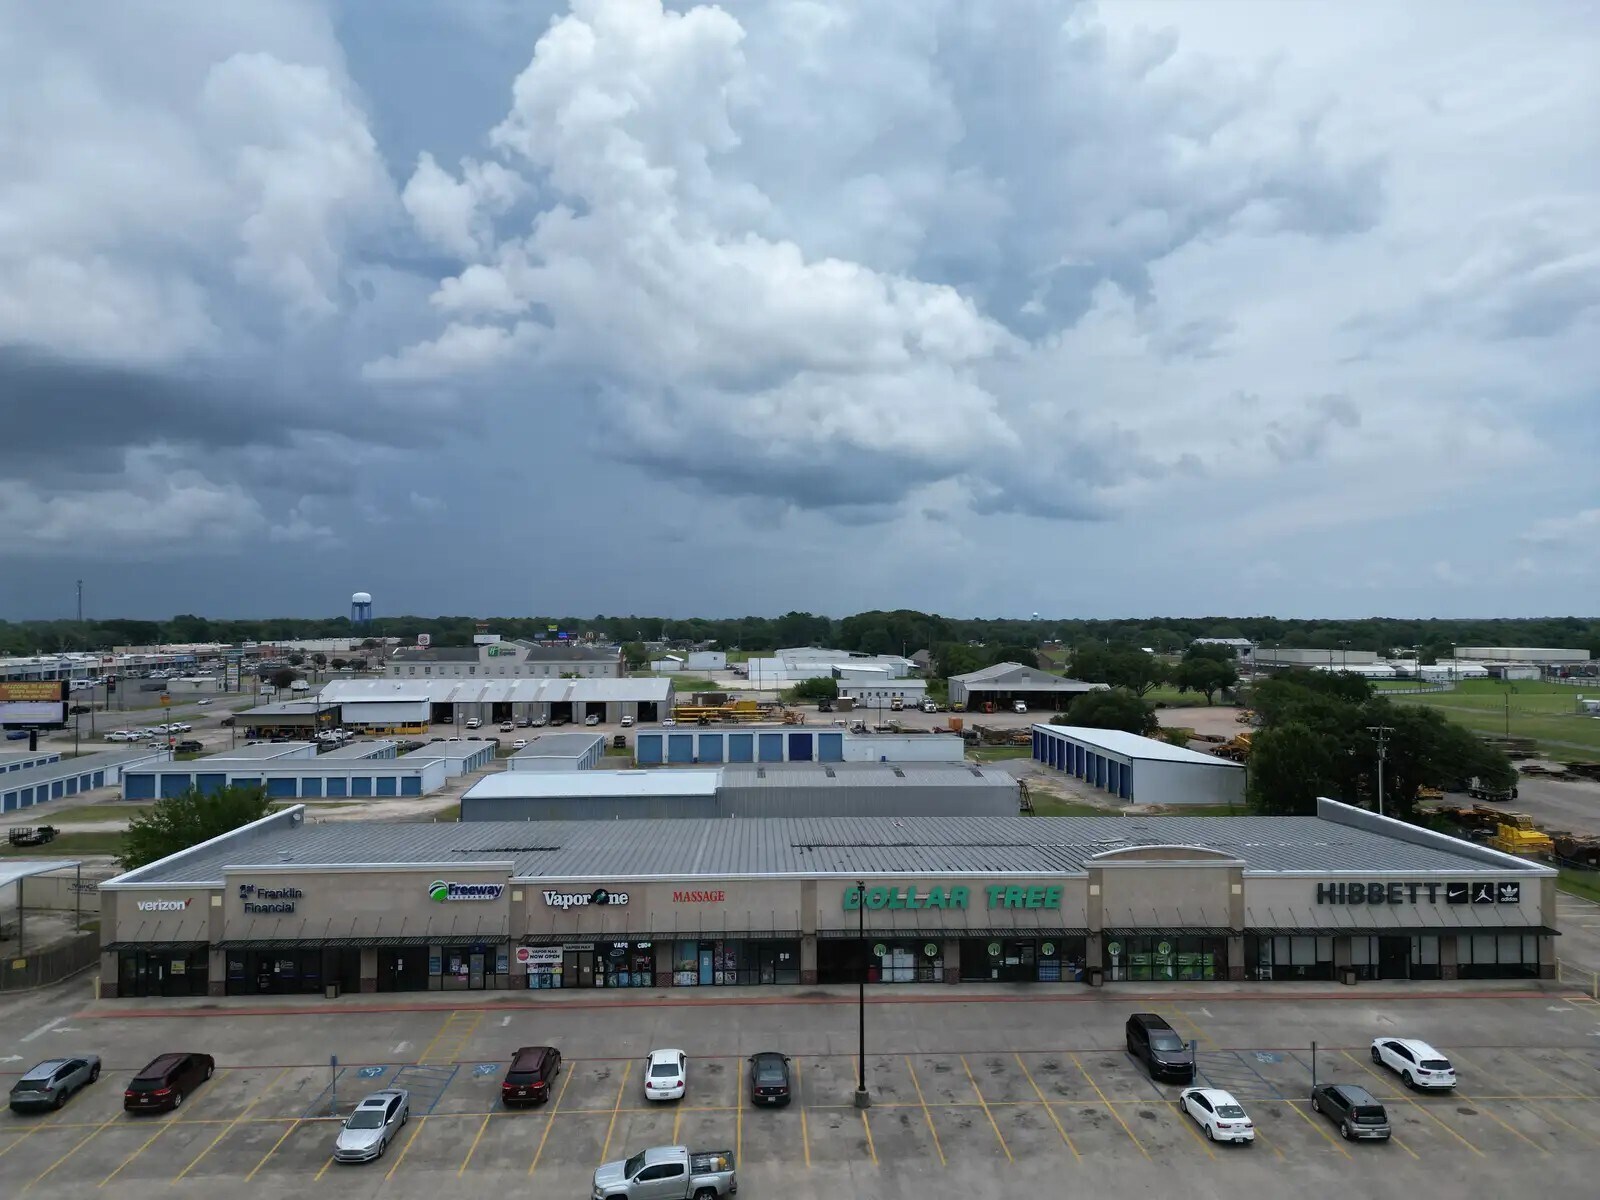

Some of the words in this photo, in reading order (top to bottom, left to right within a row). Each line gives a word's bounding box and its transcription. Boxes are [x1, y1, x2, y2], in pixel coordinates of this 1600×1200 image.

[239, 884, 256, 899] 1st
[257, 887, 303, 899] Franklin
[448, 882, 505, 897] Freeway
[672, 890, 725, 903] MASSAGE
[1317, 882, 1442, 904] HIBBETT
[137, 899, 185, 911] verizon
[843, 886, 970, 910] DOLLAR
[986, 885, 1064, 909] TREE
[244, 901, 295, 913] Financial
